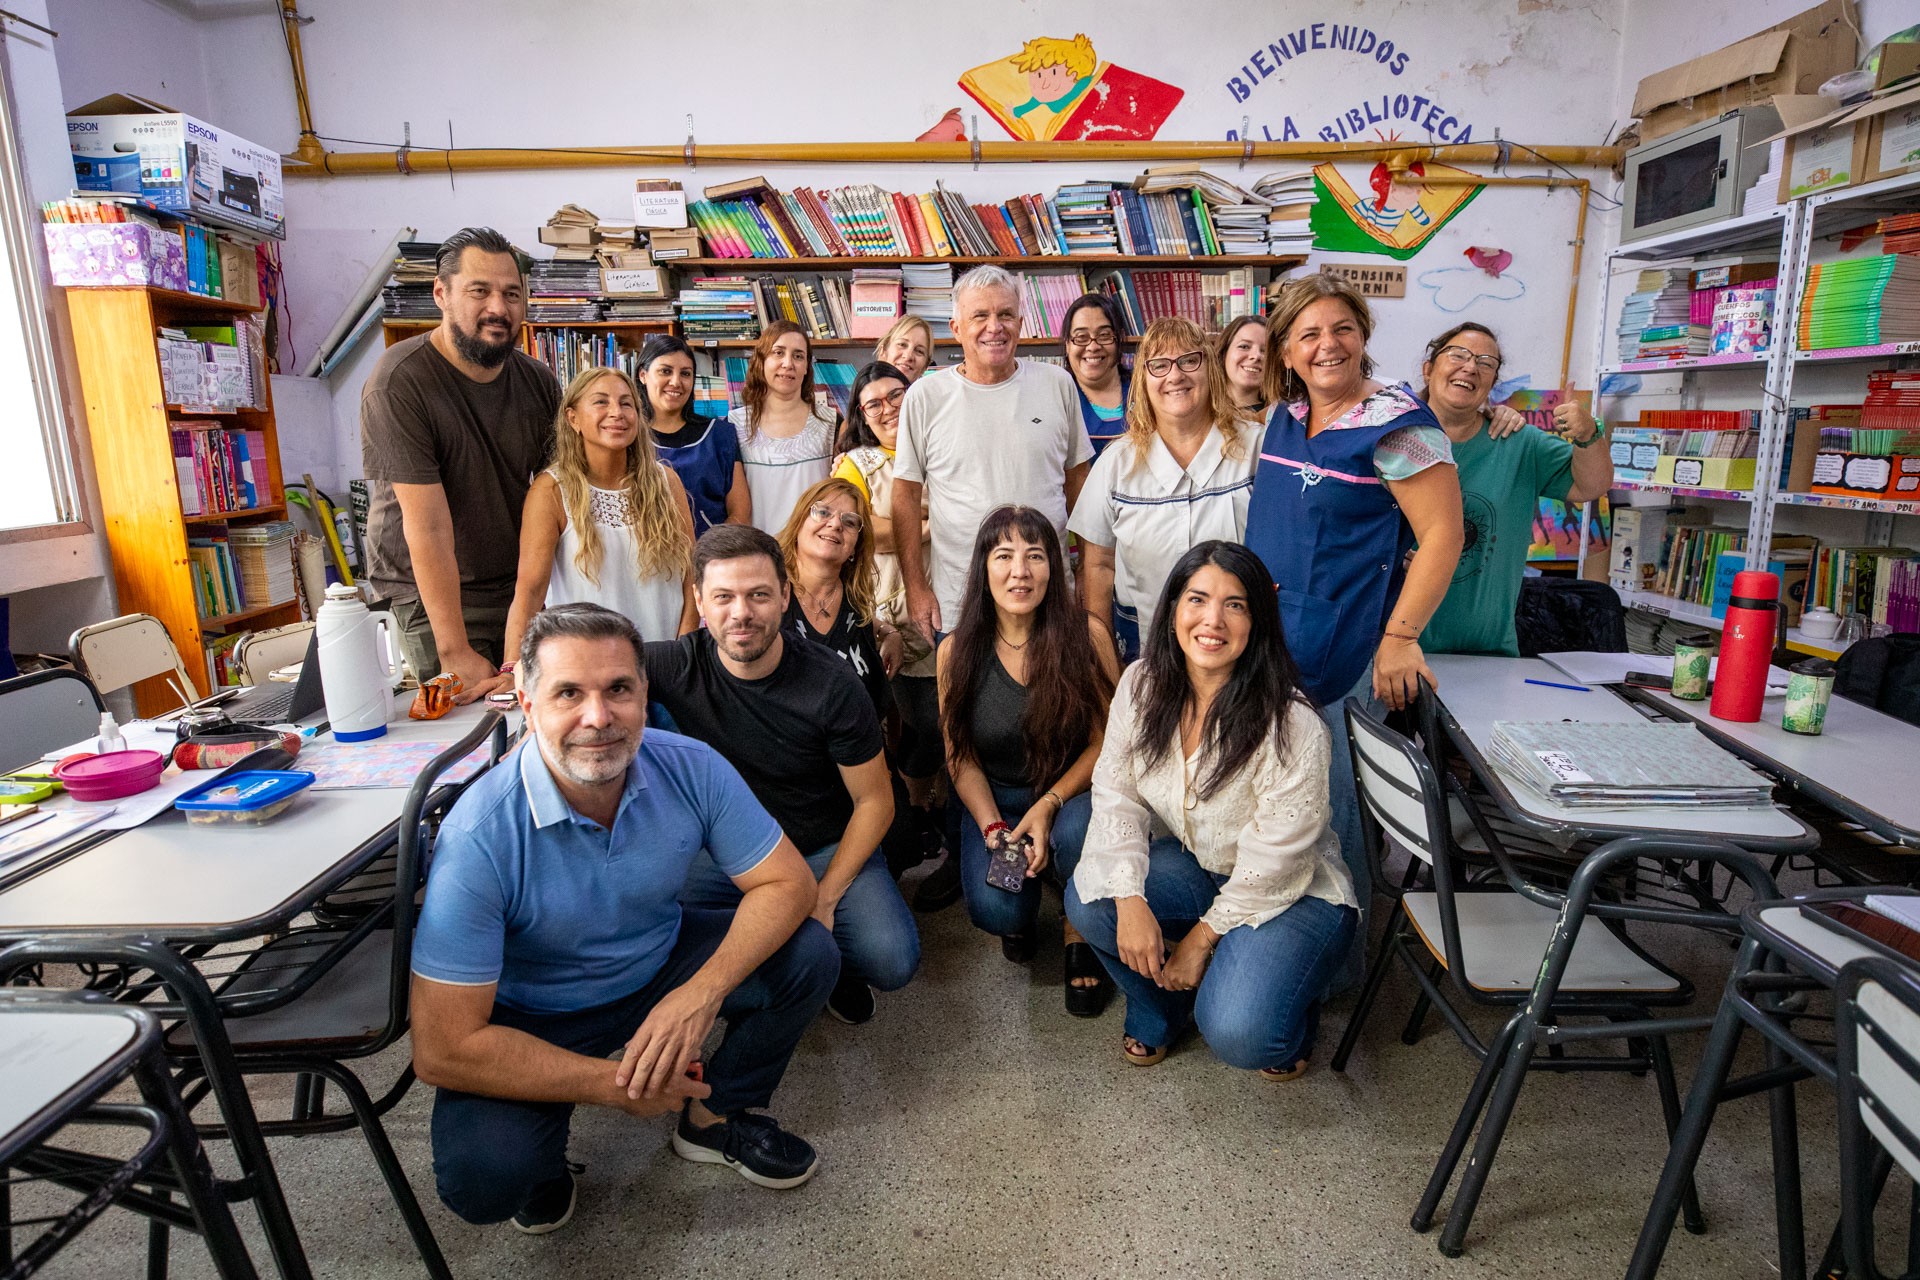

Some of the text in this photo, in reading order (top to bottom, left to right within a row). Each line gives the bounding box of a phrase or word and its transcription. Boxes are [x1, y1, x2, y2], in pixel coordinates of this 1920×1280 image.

[1226, 22, 1410, 103] BIENVENIDOS
[67, 122, 98, 131] EPSON
[187, 122, 218, 143] EPSON
[1262, 116, 1300, 141] LA
[1318, 93, 1473, 143] BIBLIOTECA
